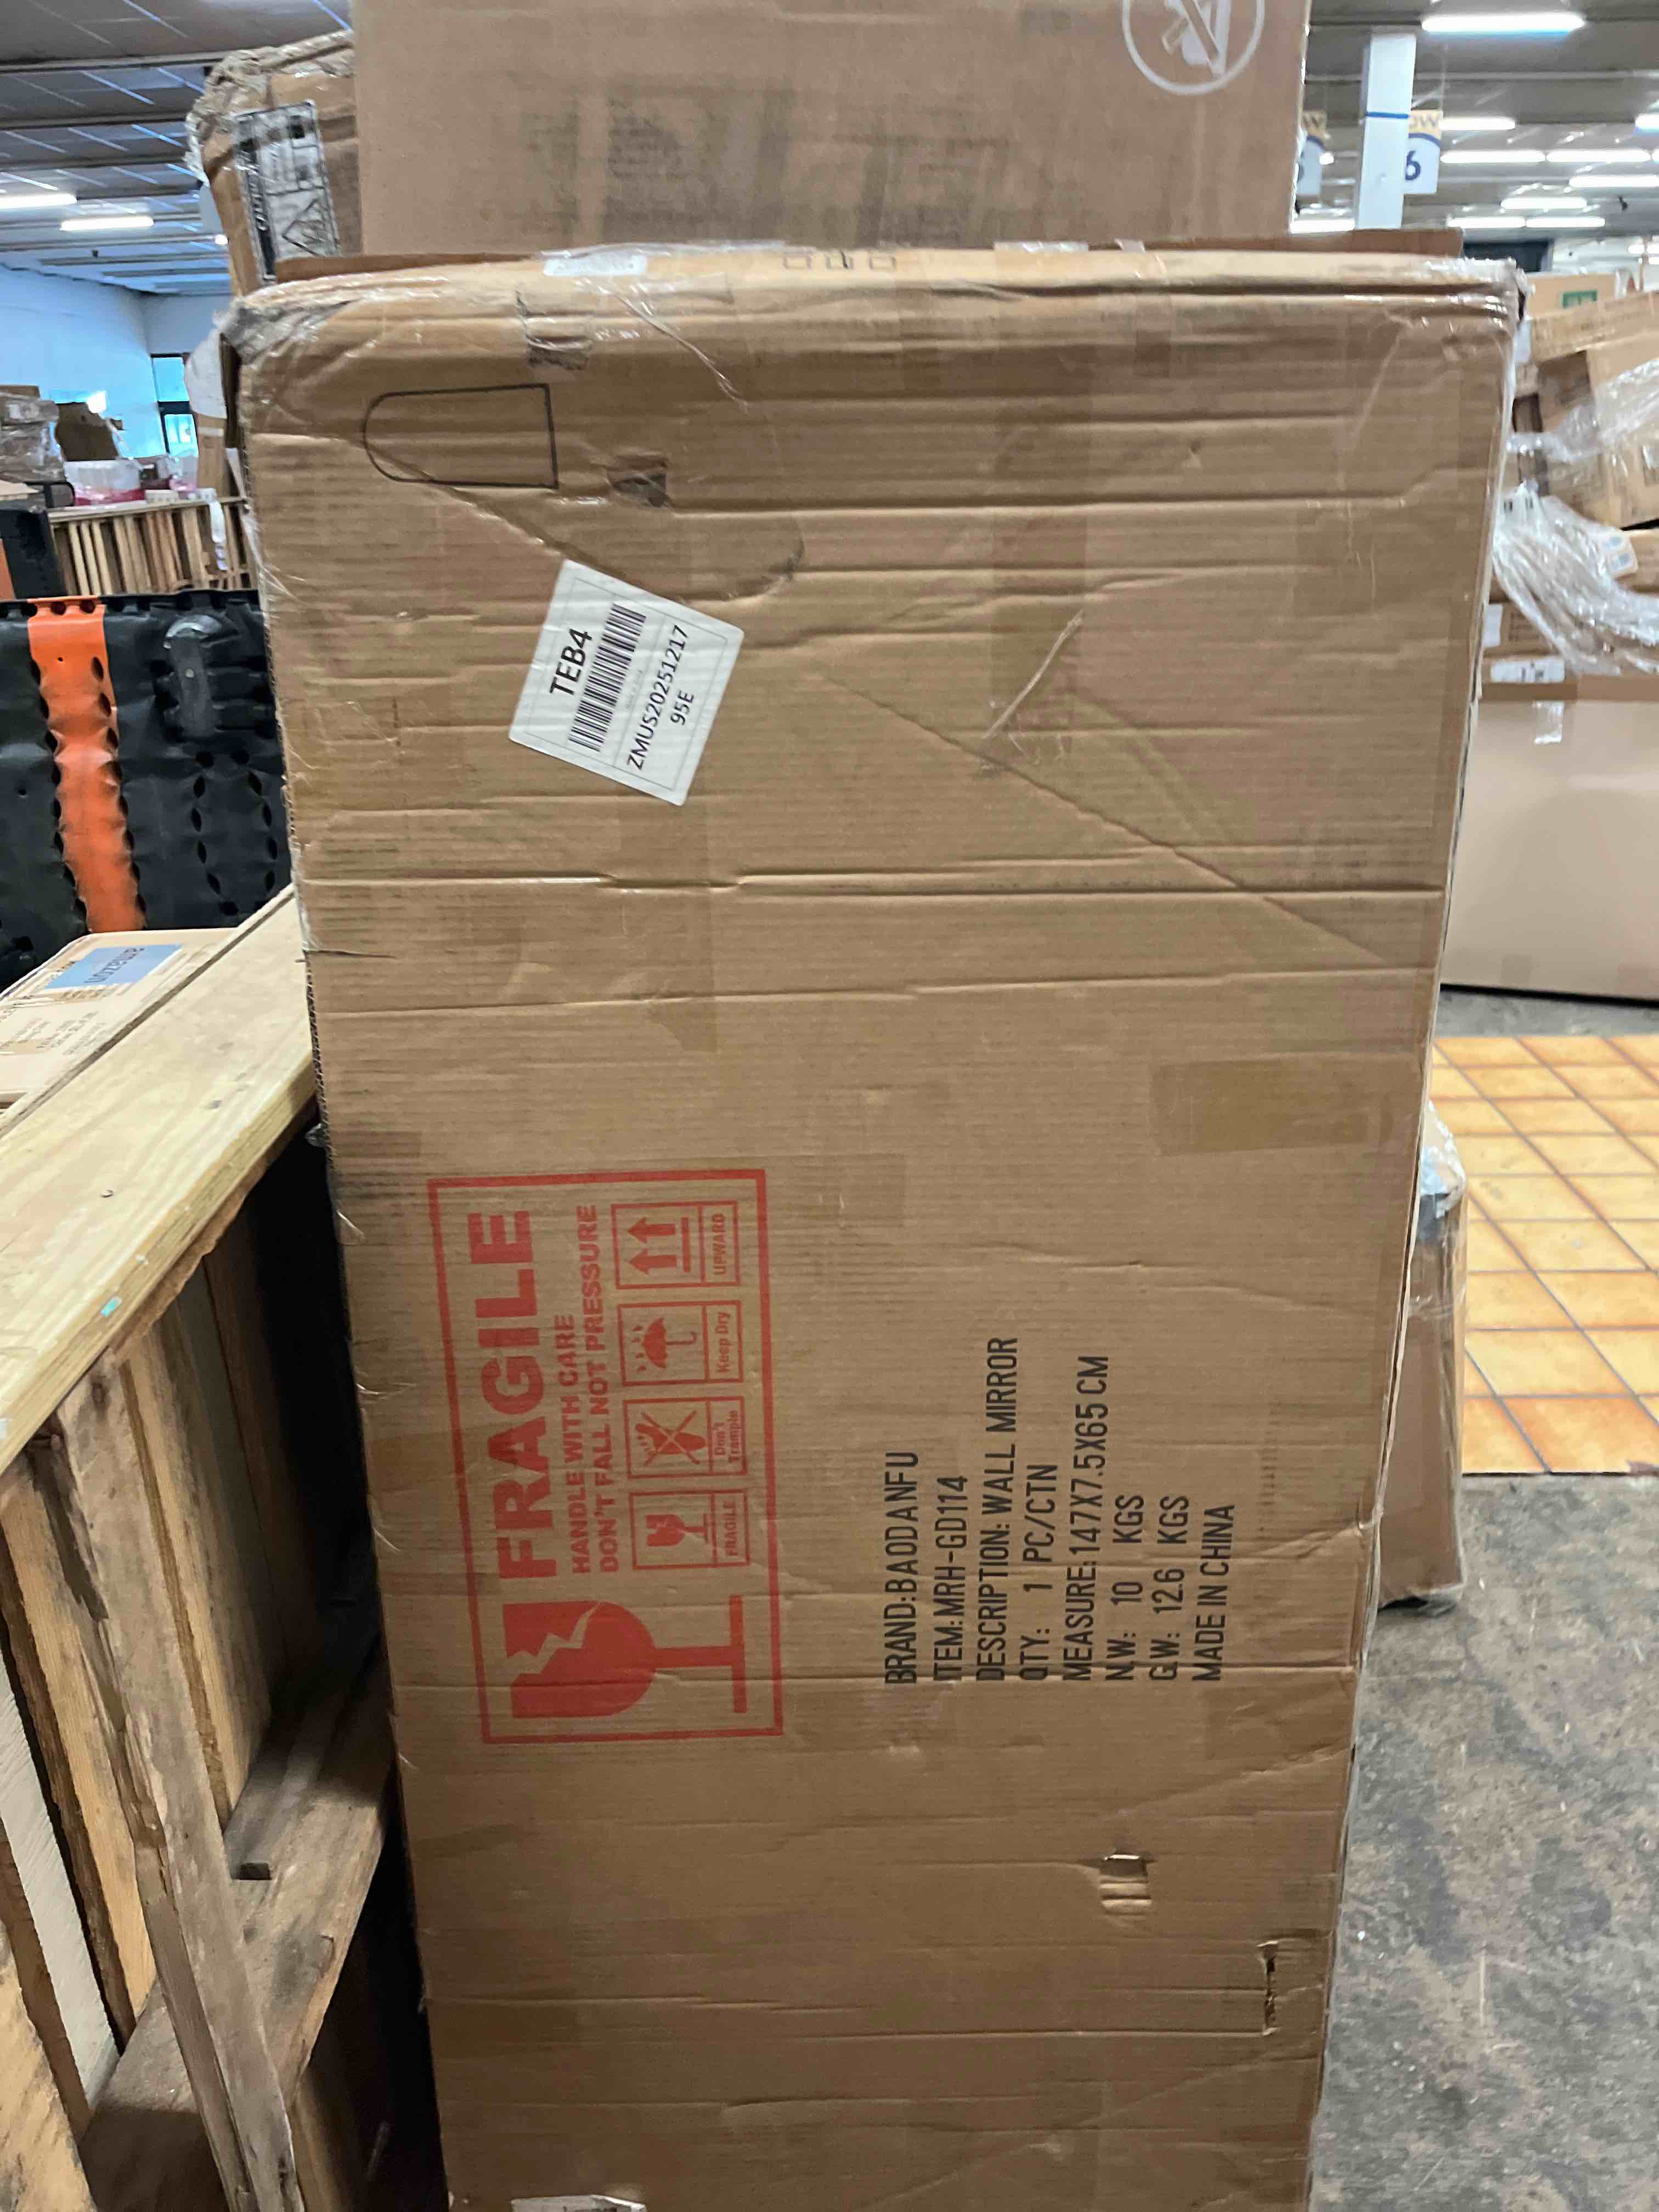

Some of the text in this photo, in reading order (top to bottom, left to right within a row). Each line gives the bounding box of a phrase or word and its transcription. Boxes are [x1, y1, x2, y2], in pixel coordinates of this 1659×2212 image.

[549, 629, 592, 696] TEB4
[627, 624, 689, 770] ZMUS20251217
[670, 690, 695, 726] 95E
[83, 947, 145, 983] amazon
[712, 1213, 726, 1275] UPWARD
[715, 1312, 731, 1373] Keep Dry
[467, 1211, 557, 1579] FRAGILE
[577, 1205, 619, 1572] DON'T FALL NOT PRESSURE
[1076, 1356, 1109, 1395] CM
[553, 1314, 591, 1573] HANDLE WITH CARE
[727, 1409, 742, 1464] Trample
[724, 1500, 738, 1556] FRAGILE
[976, 1337, 1018, 1681] DESCRIPTION: WALL MIRROR
[1112, 1495, 1144, 1543] KGS
[1157, 1496, 1189, 1544] KGS
[1019, 1465, 1058, 1680] QTY: 1 PC/CTN
[1110, 1582, 1143, 1605] 10
[1151, 1568, 1185, 1614] 12.6
[1192, 1505, 1235, 1681] MADE IN CHINA
